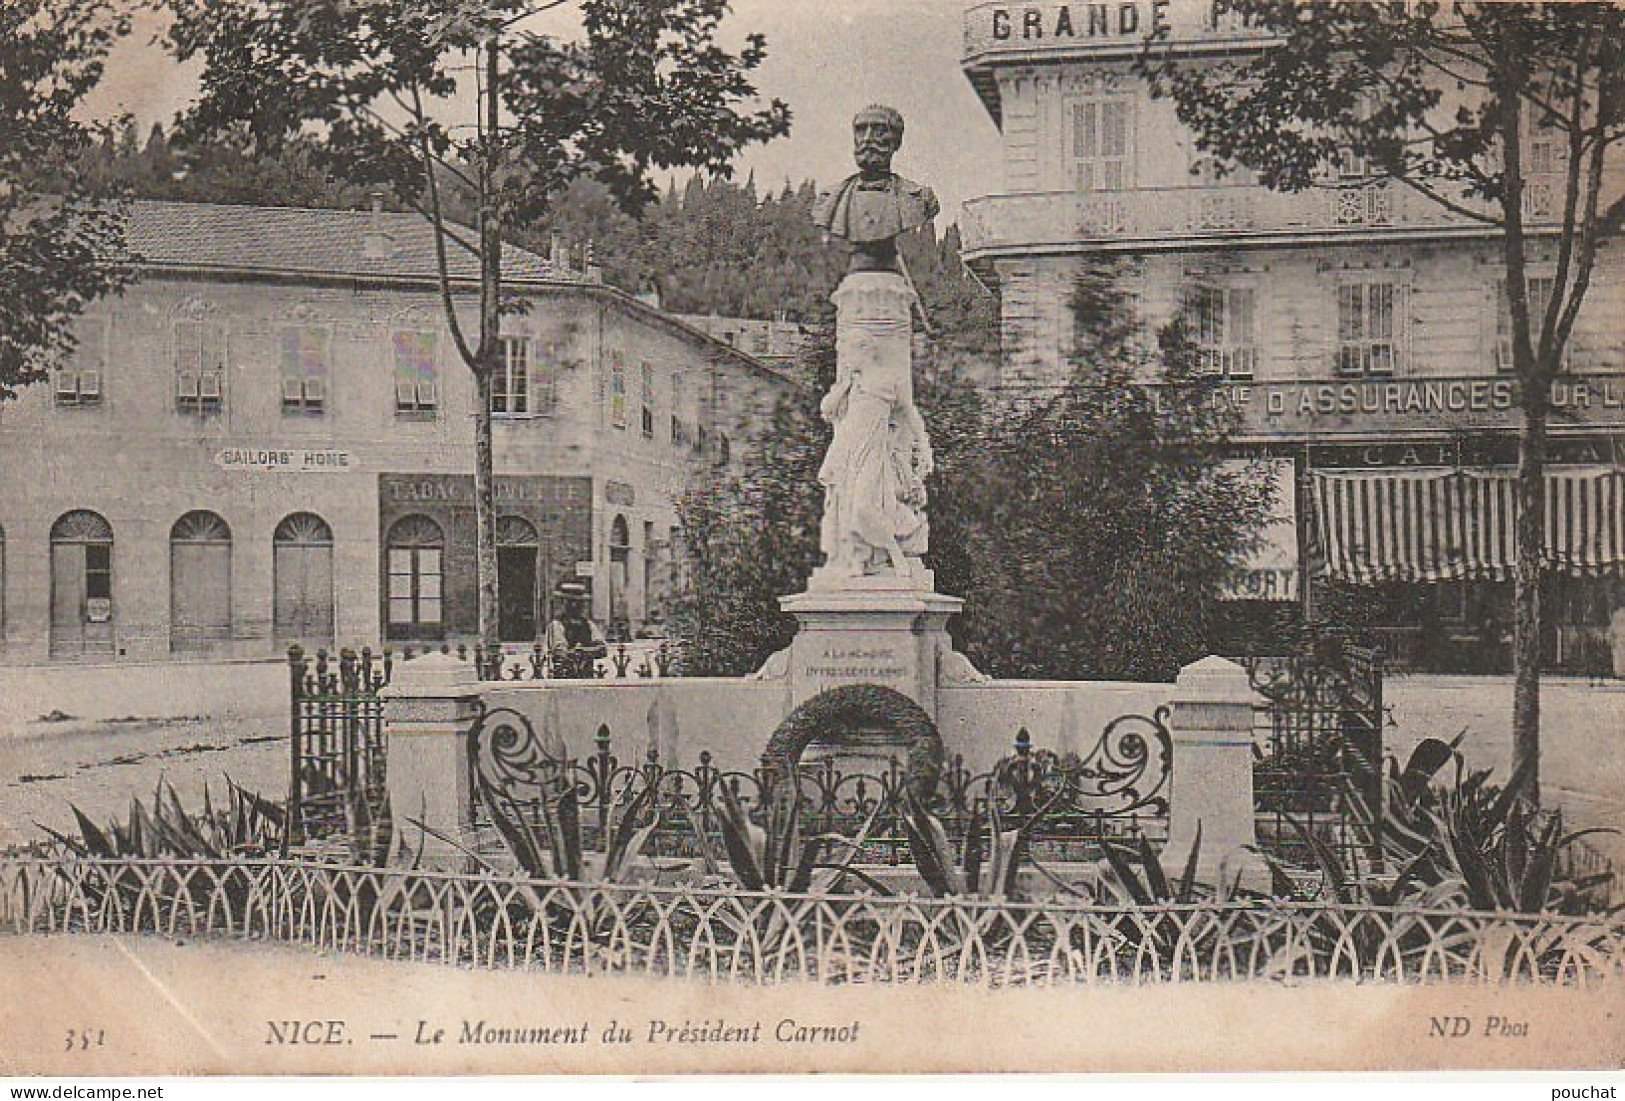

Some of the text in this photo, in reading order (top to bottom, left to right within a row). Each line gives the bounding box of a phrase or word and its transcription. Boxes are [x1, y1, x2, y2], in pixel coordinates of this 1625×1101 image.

[993, 1, 1171, 40] GRANDE
[1267, 380, 1512, 413] D'ASSURANCES
[1550, 379, 1590, 408] UR
[304, 453, 350, 466] HOME
